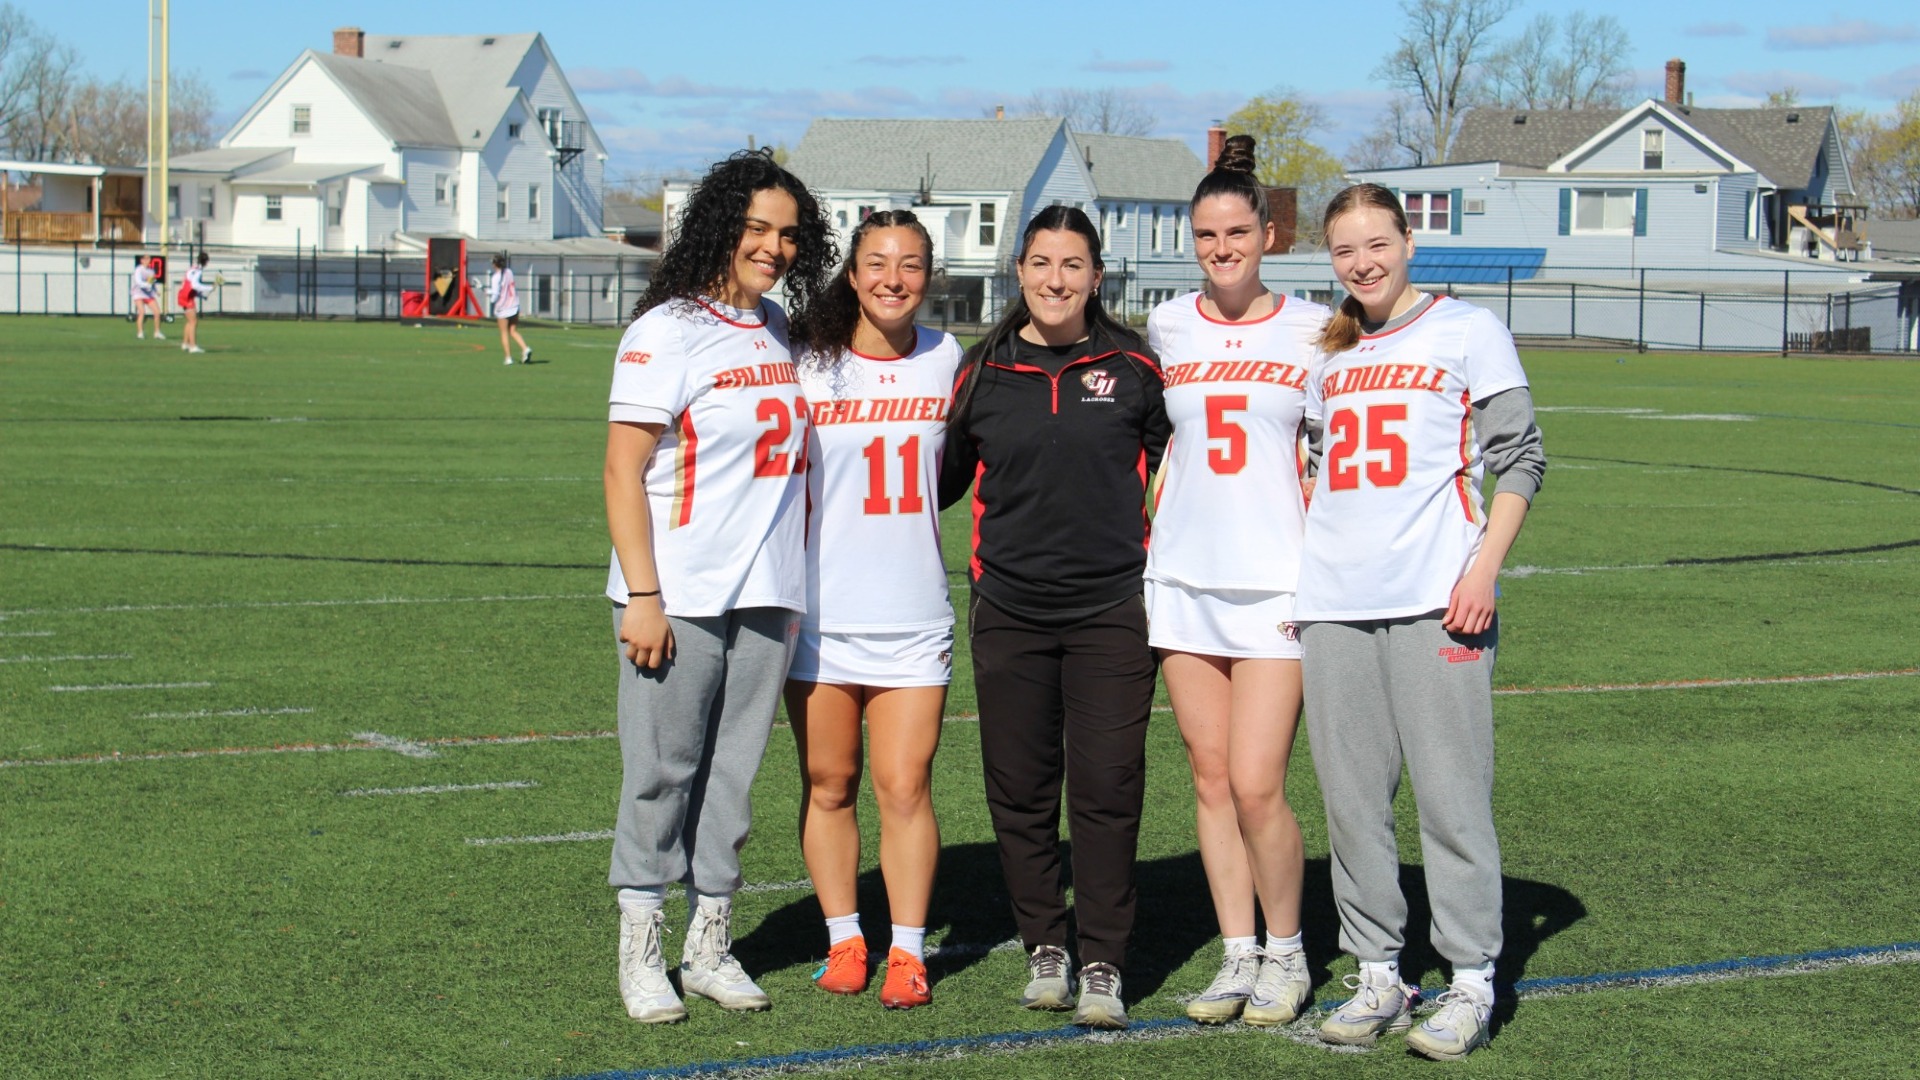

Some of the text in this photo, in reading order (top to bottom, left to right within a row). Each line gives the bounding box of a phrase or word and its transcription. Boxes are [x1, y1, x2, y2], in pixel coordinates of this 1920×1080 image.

[619, 351, 651, 364] CACC
[809, 397, 949, 426] CALDWEL
[1205, 394, 1249, 475] 5
[1329, 403, 1408, 492] 25
[863, 435, 922, 514] 11
